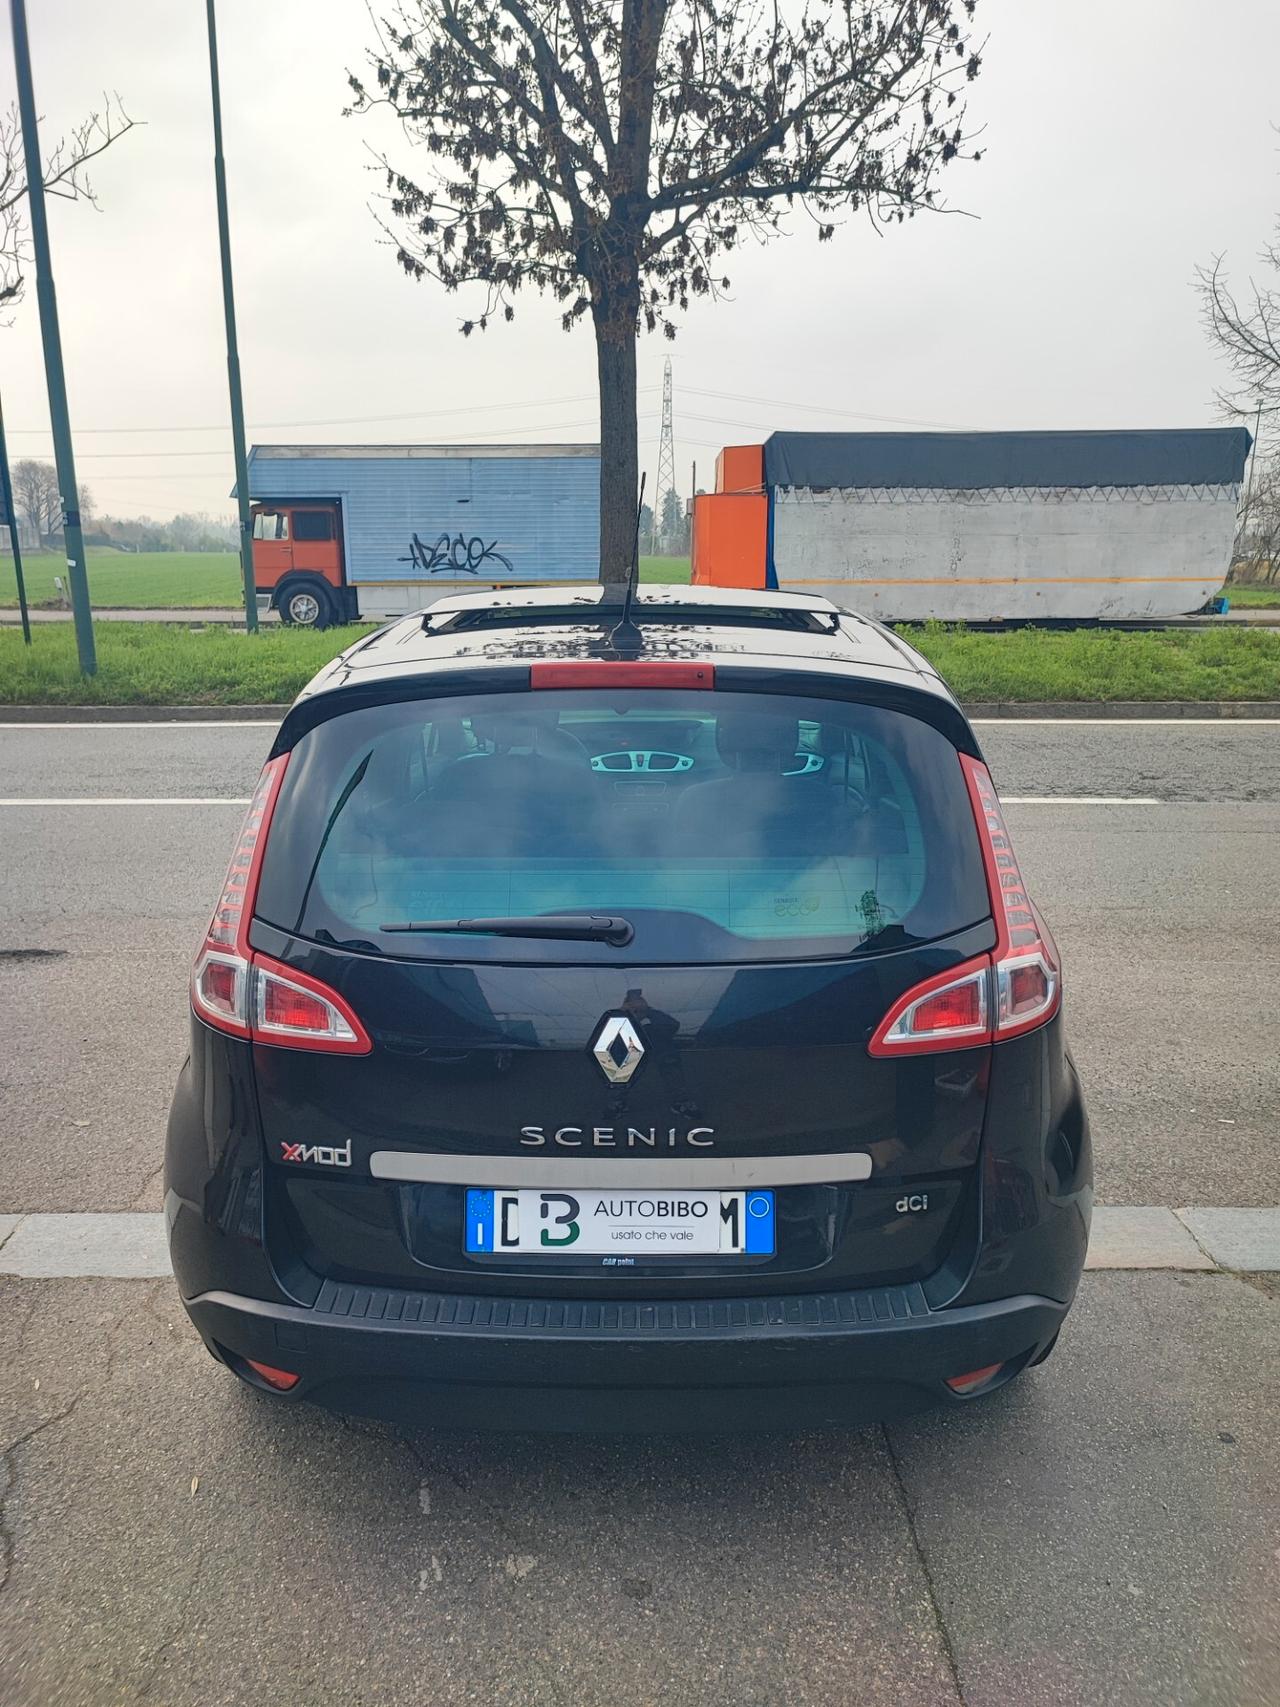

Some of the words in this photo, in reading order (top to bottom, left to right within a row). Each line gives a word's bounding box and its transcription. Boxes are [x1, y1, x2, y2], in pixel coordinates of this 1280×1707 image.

[519, 1127, 715, 1148] SCENIC
[593, 1200, 709, 1217] AUTOBIBO
[611, 1230, 642, 1240] usato
[645, 1230, 667, 1240] che
[670, 1230, 694, 1241] vale
